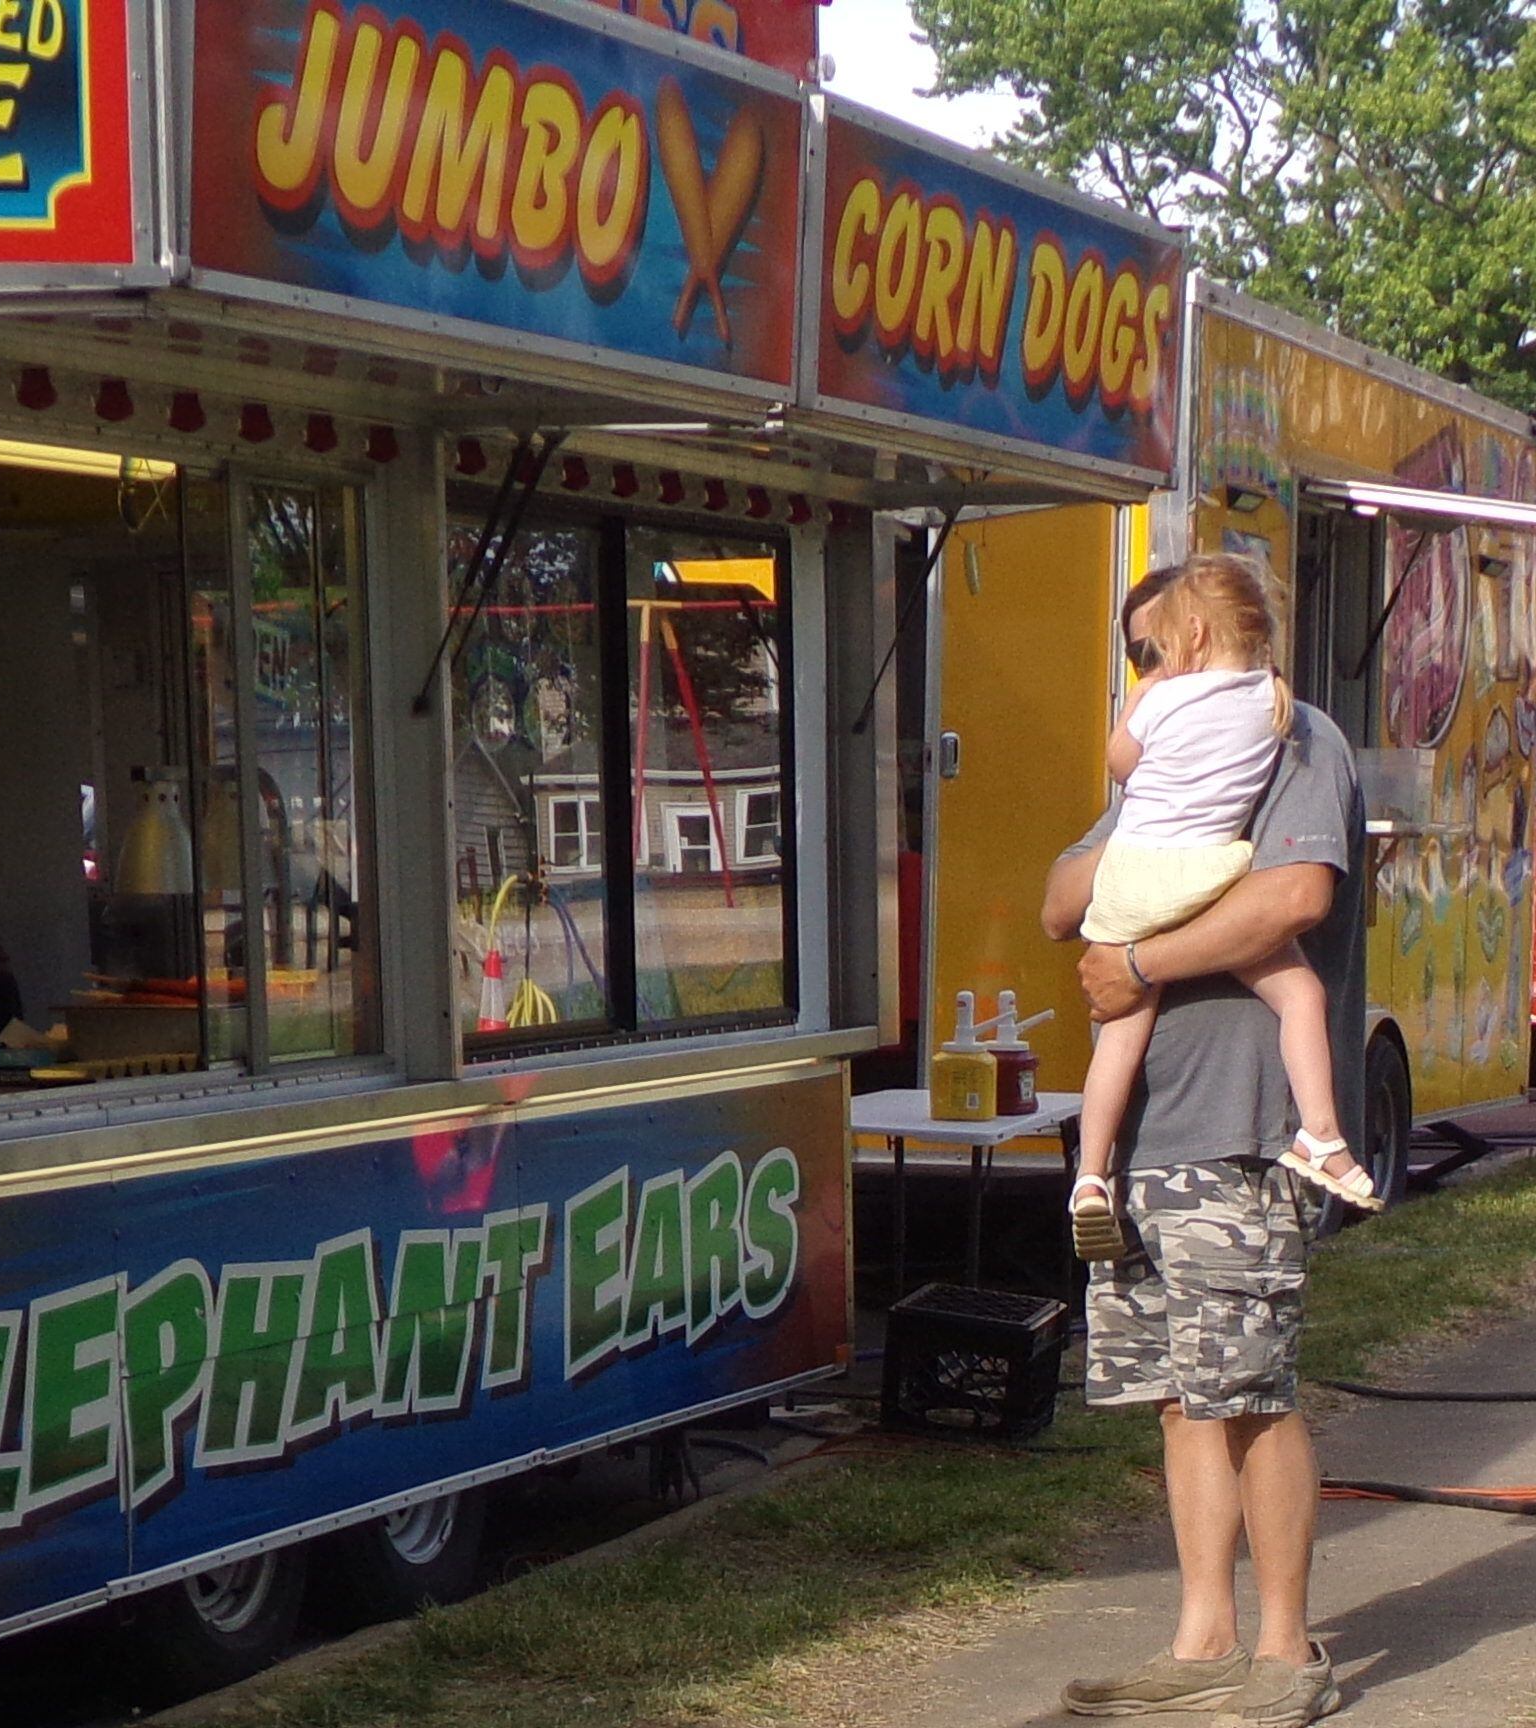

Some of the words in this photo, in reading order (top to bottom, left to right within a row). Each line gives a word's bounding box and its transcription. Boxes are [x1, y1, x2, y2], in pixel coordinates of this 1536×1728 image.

[256, 7, 642, 268] JUMBO
[831, 178, 1015, 359] CORN
[1023, 242, 1170, 402] DOGS
[564, 1146, 801, 1381] EARS
